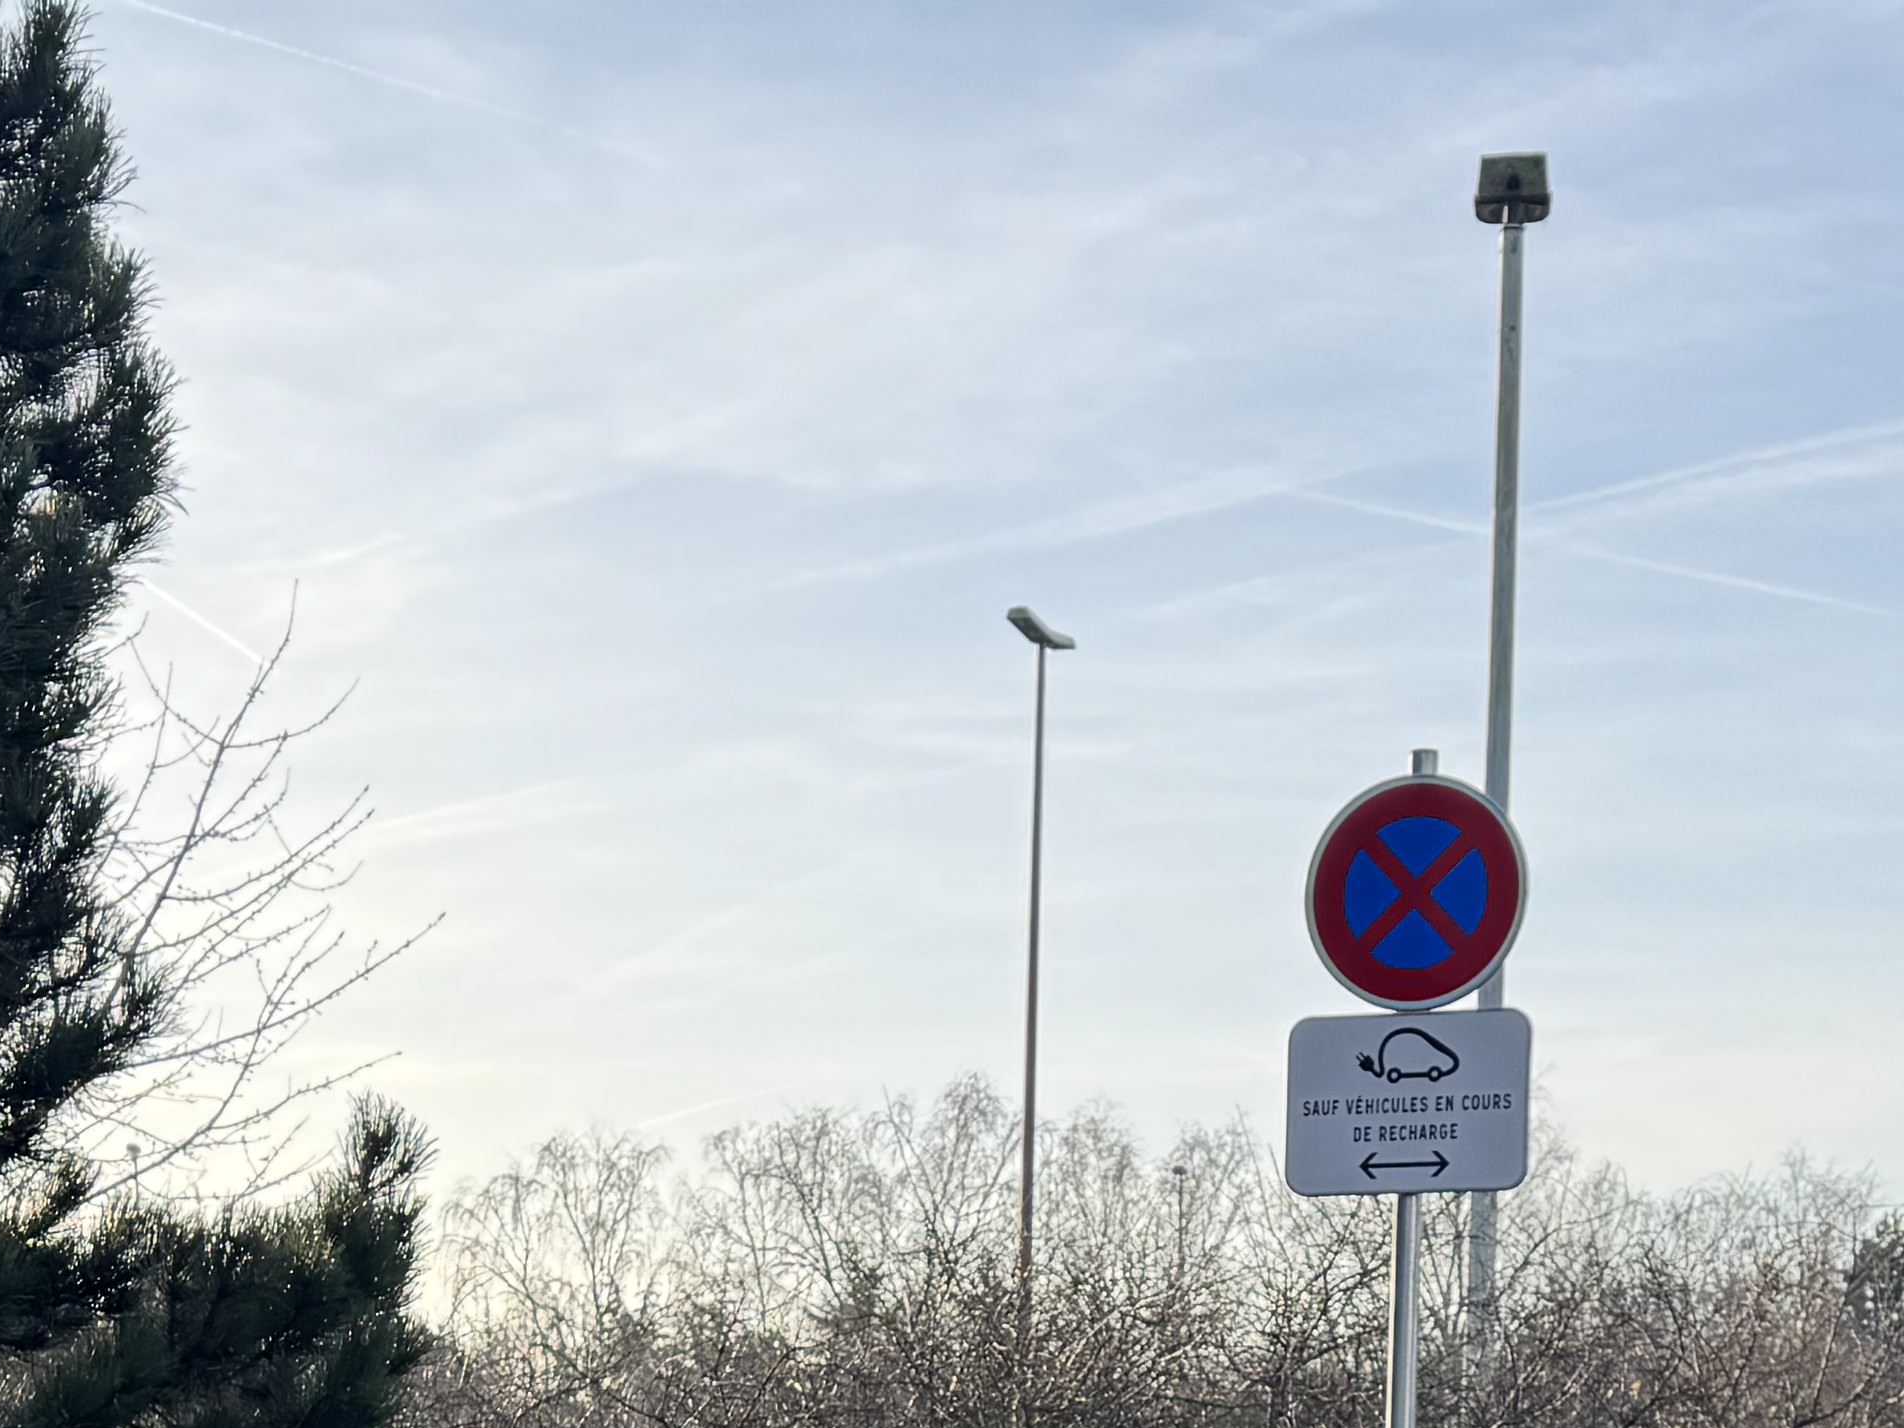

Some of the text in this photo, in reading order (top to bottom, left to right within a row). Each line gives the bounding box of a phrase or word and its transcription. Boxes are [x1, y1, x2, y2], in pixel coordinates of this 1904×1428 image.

[1303, 1093, 1511, 1116] SAUF VÉHICULES EN COURS
[1353, 1123, 1458, 1142] DE RECHARGE
